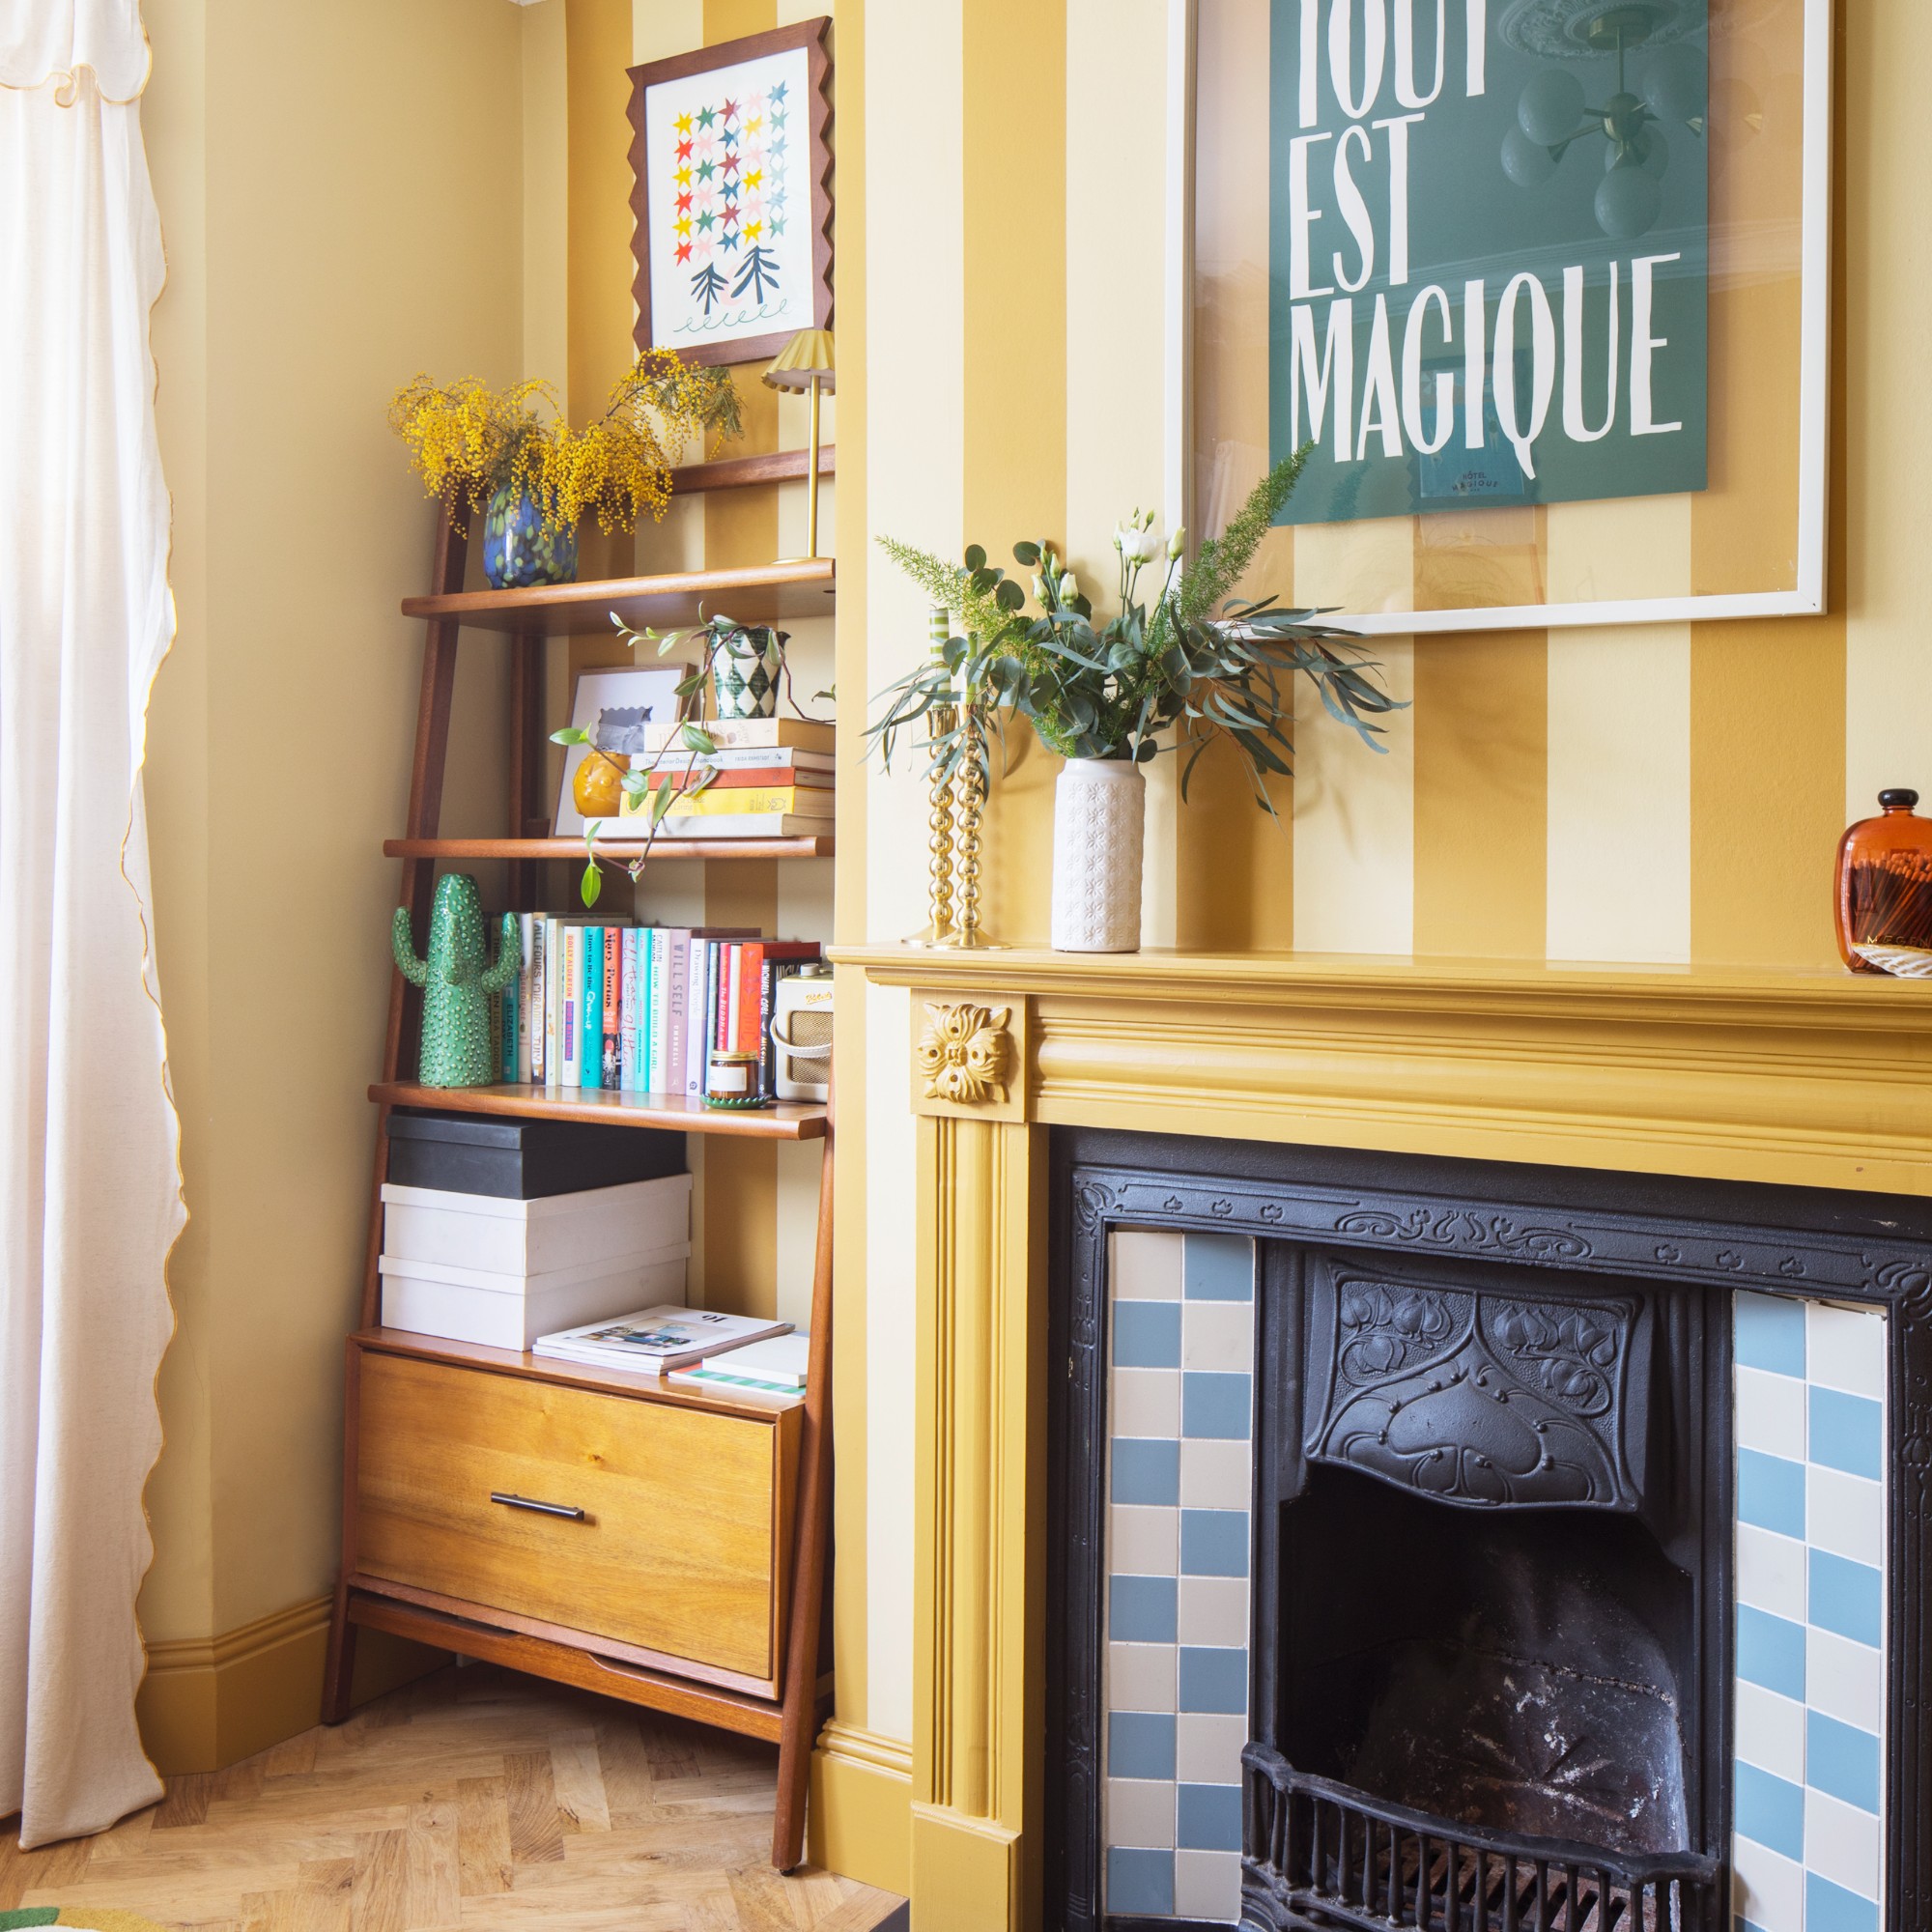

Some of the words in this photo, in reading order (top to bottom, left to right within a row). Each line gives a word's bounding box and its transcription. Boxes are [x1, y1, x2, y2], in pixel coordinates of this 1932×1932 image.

[1290, 112, 1426, 300] EST
[1290, 252, 1683, 480] MAGIQUE
[1463, 470, 1487, 480] HÔTEL
[533, 924, 543, 943] ALL
[605, 932, 616, 961] Mary
[533, 945, 543, 979] FOURS
[587, 953, 593, 963] to
[672, 944, 684, 979] WILL
[692, 949, 702, 986] Drawing
[605, 964, 615, 1008] Portas
[653, 993, 659, 1007] TO
[671, 984, 683, 1017] SELF
[532, 983, 542, 1032] MIRANDA
[532, 1035, 542, 1062] JULY
